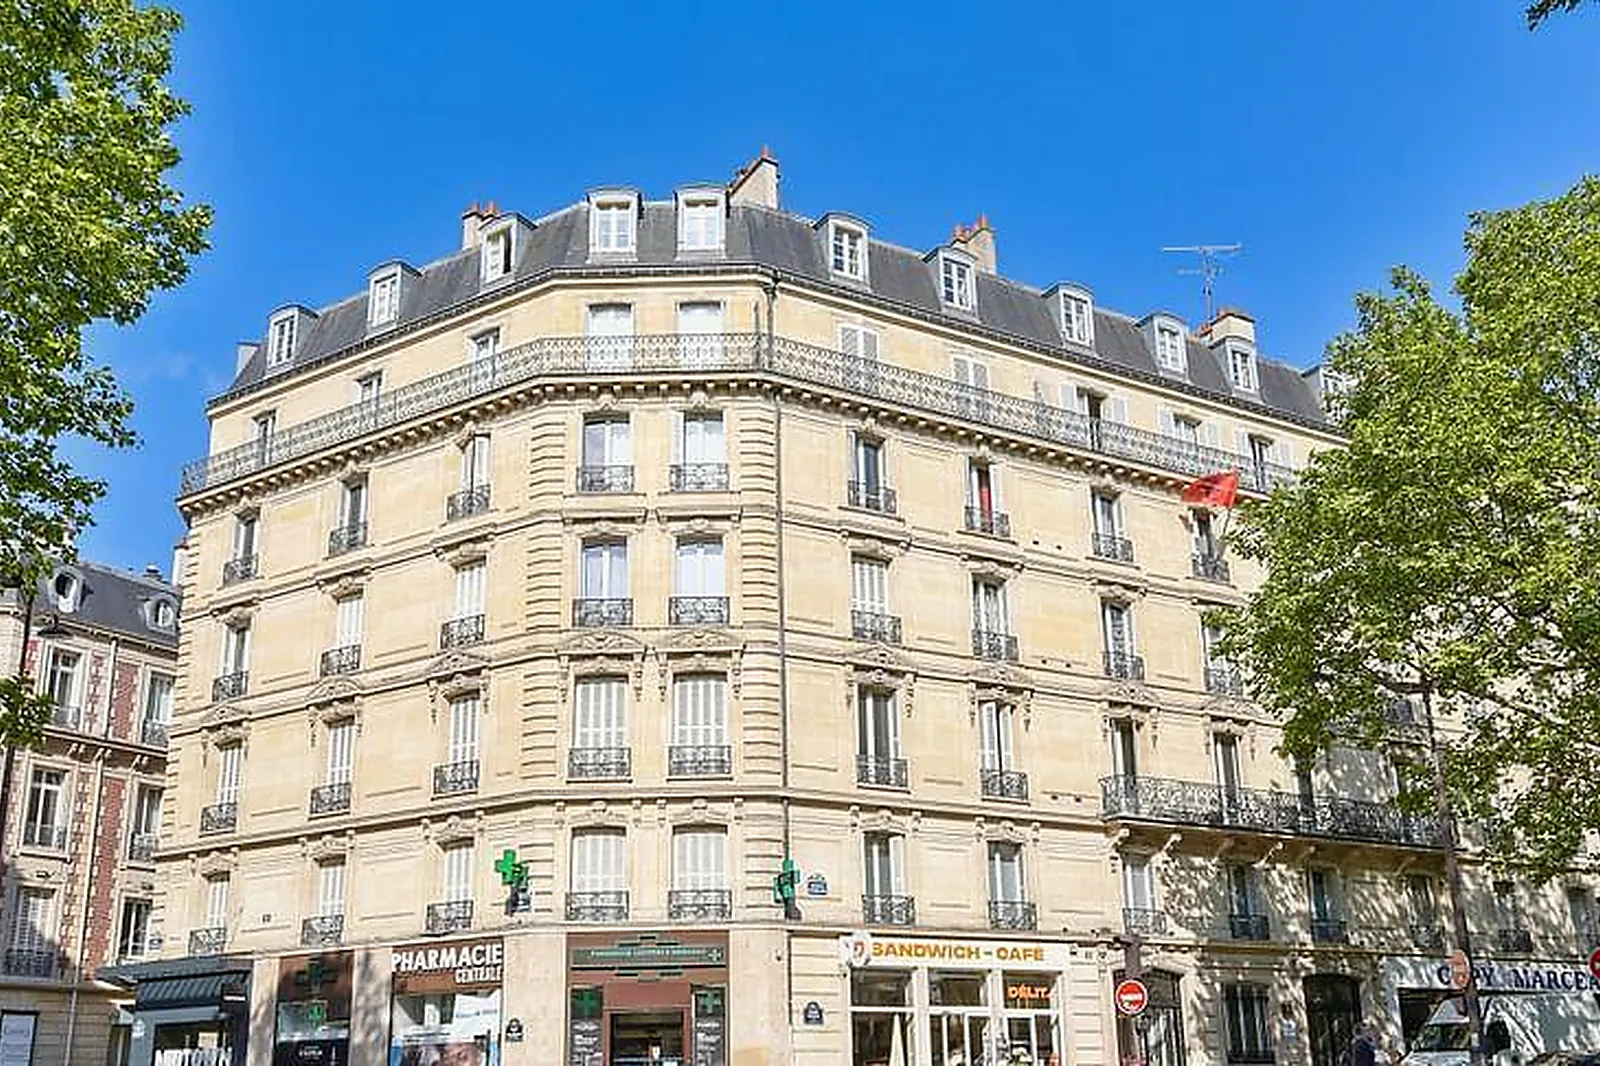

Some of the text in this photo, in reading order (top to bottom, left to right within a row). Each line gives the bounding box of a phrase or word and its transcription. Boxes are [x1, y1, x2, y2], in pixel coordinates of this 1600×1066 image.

[391, 944, 503, 973] PHARMACIE
[872, 942, 981, 960] SANDWICH
[1437, 966, 1494, 986] CPY
